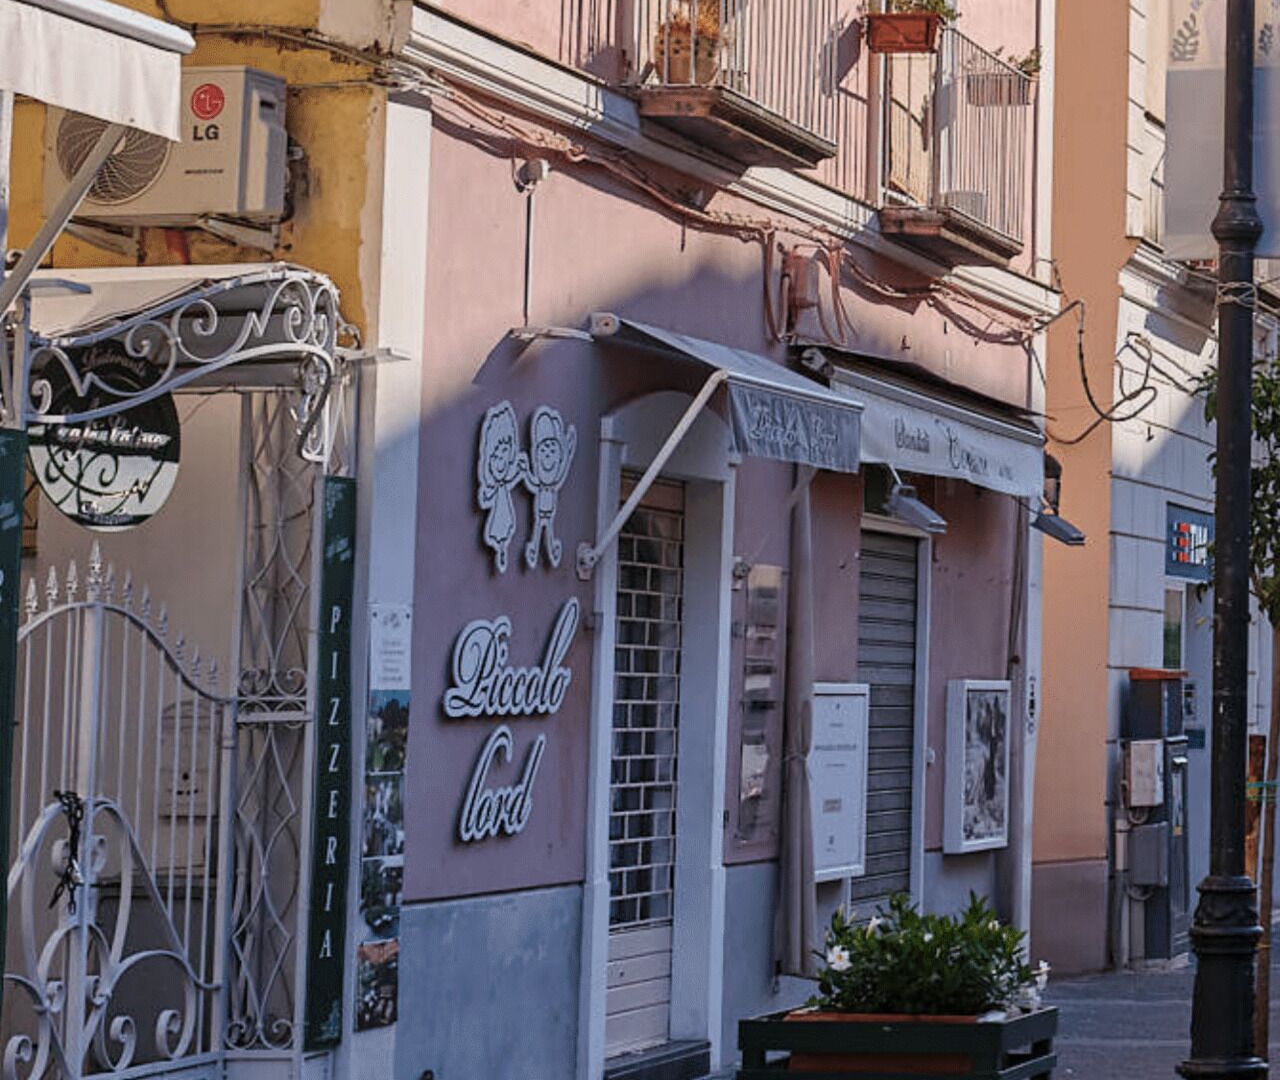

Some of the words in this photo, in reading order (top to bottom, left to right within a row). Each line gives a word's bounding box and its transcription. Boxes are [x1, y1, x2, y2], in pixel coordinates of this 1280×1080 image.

[193, 124, 220, 141] LG
[445, 598, 579, 717] Piccolo
[318, 604, 342, 960] PIZZERIA
